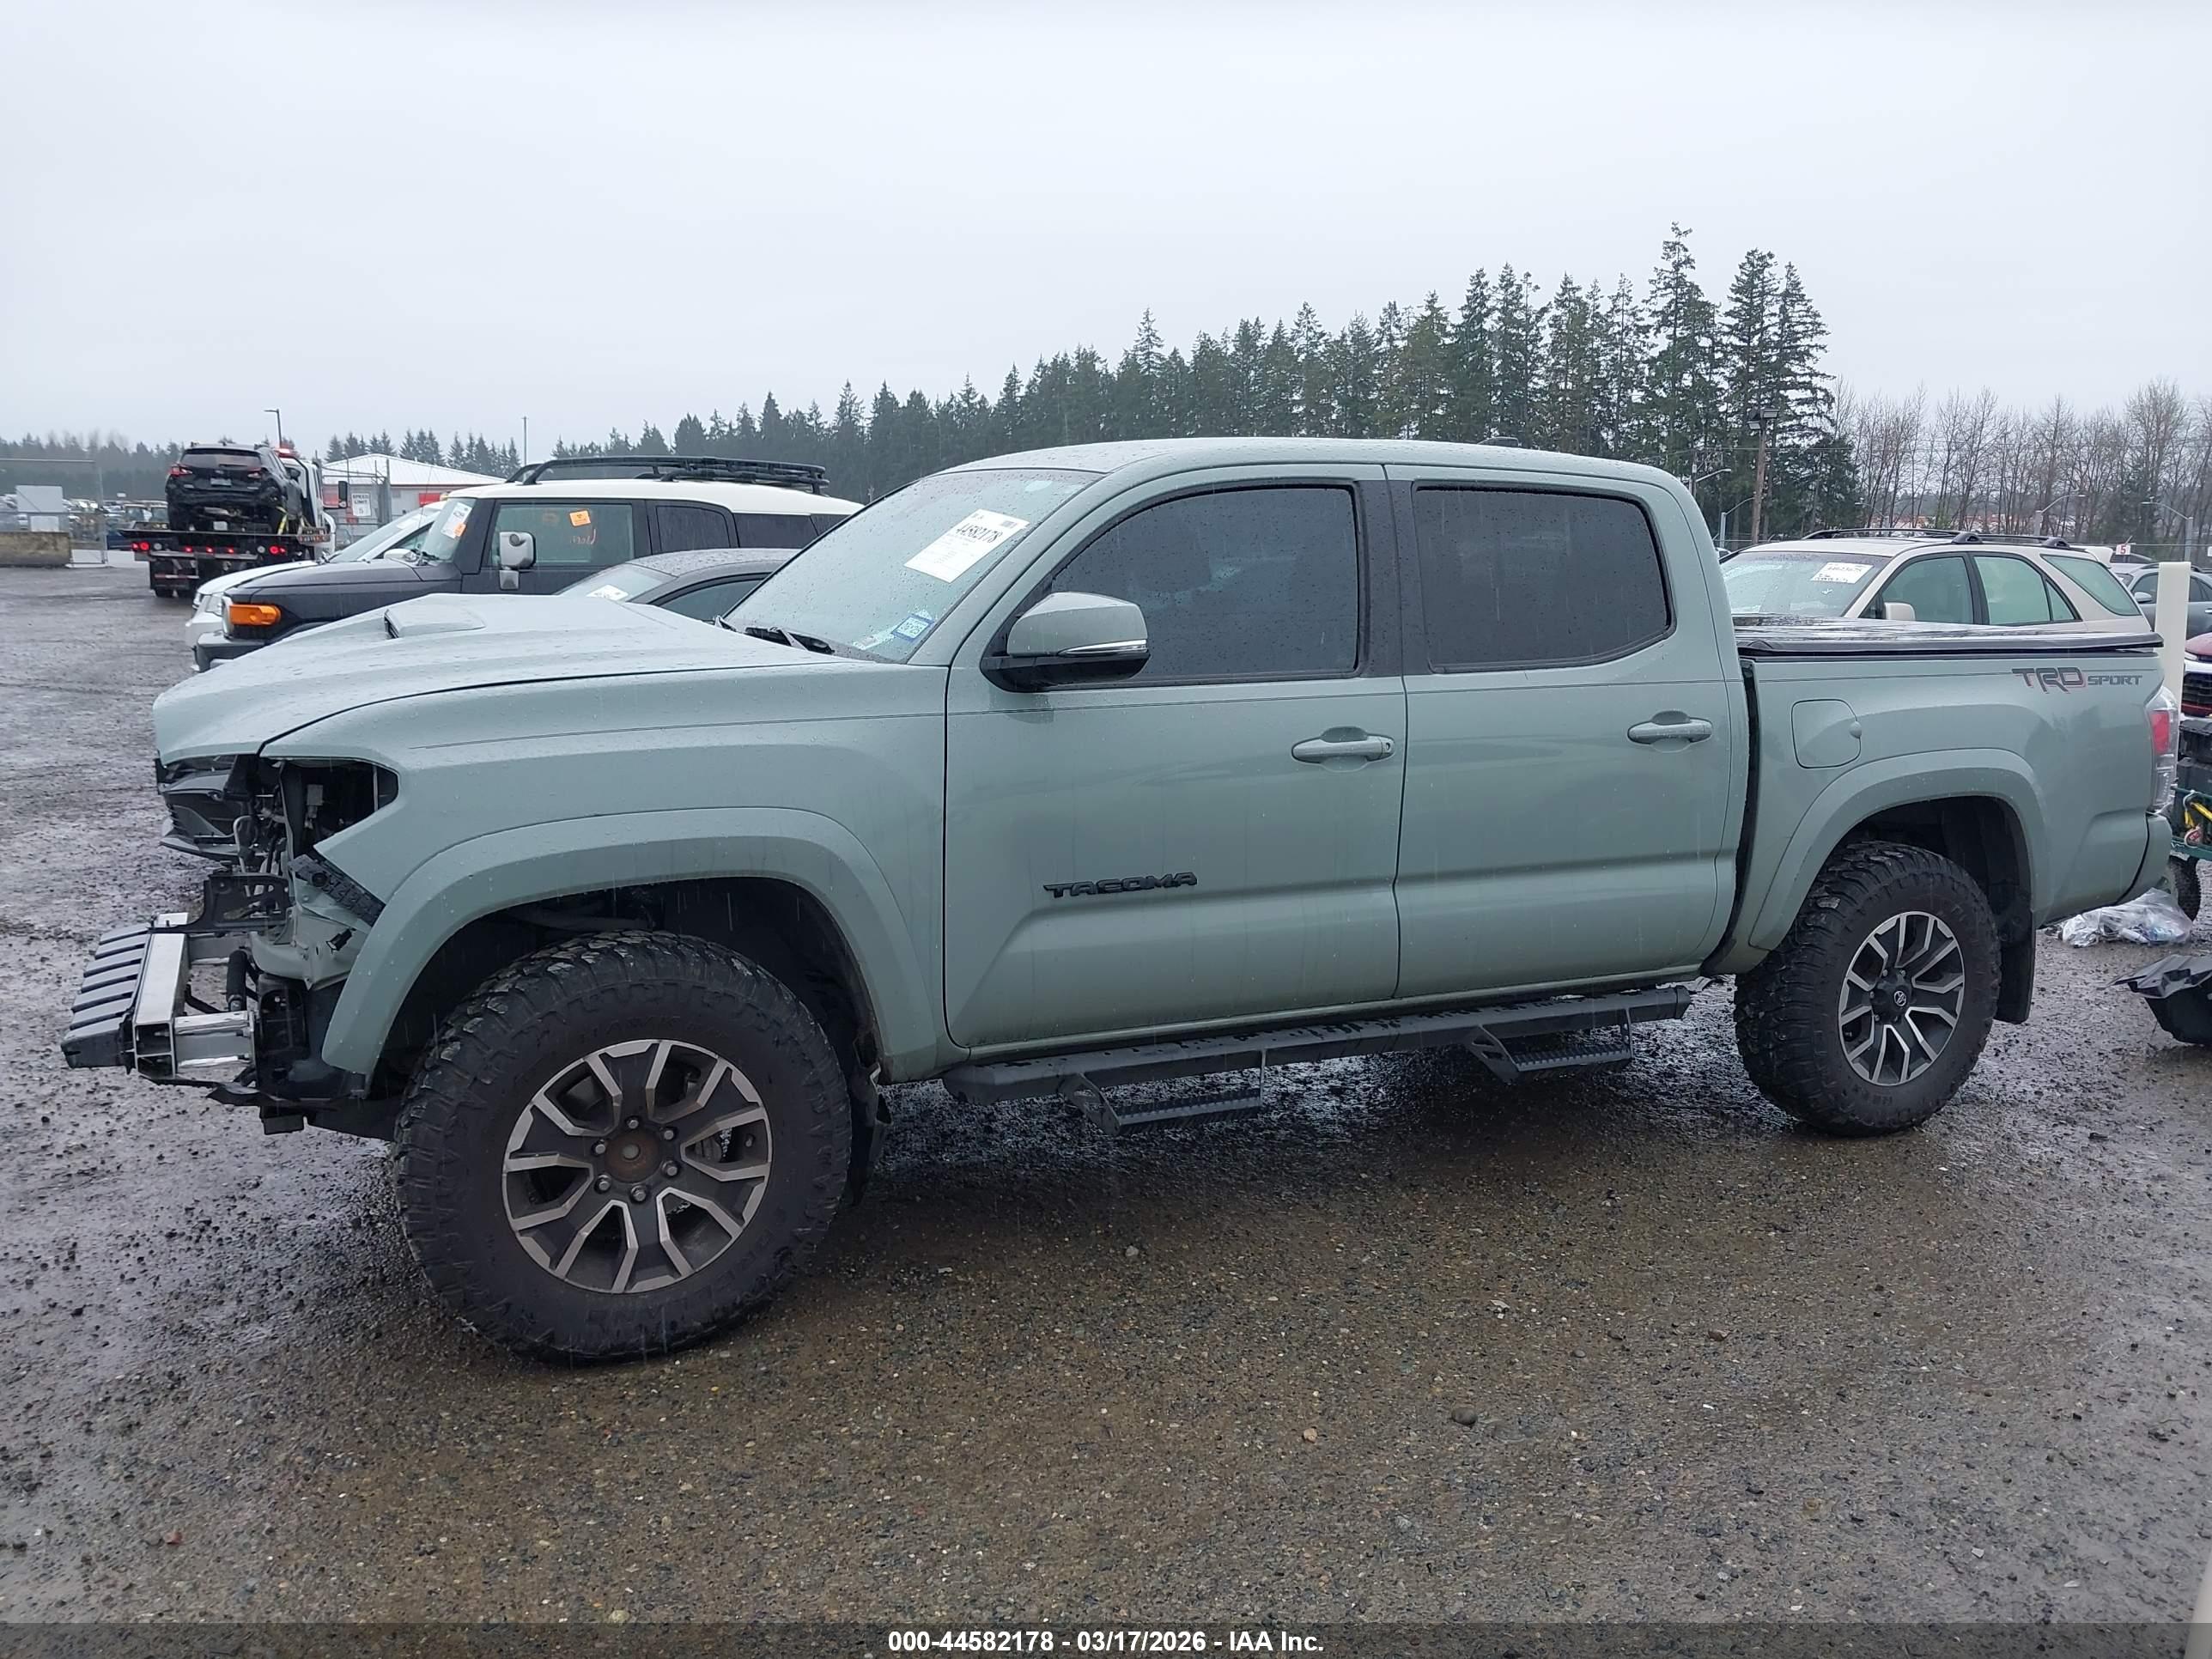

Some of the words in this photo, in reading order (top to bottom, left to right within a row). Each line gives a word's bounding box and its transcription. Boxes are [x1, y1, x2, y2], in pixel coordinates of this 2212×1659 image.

[2120, 544, 2127, 555] 5
[2011, 666, 2087, 695] TRD
[2087, 674, 2143, 686] SPORT
[1042, 872, 1198, 898] TACOMA
